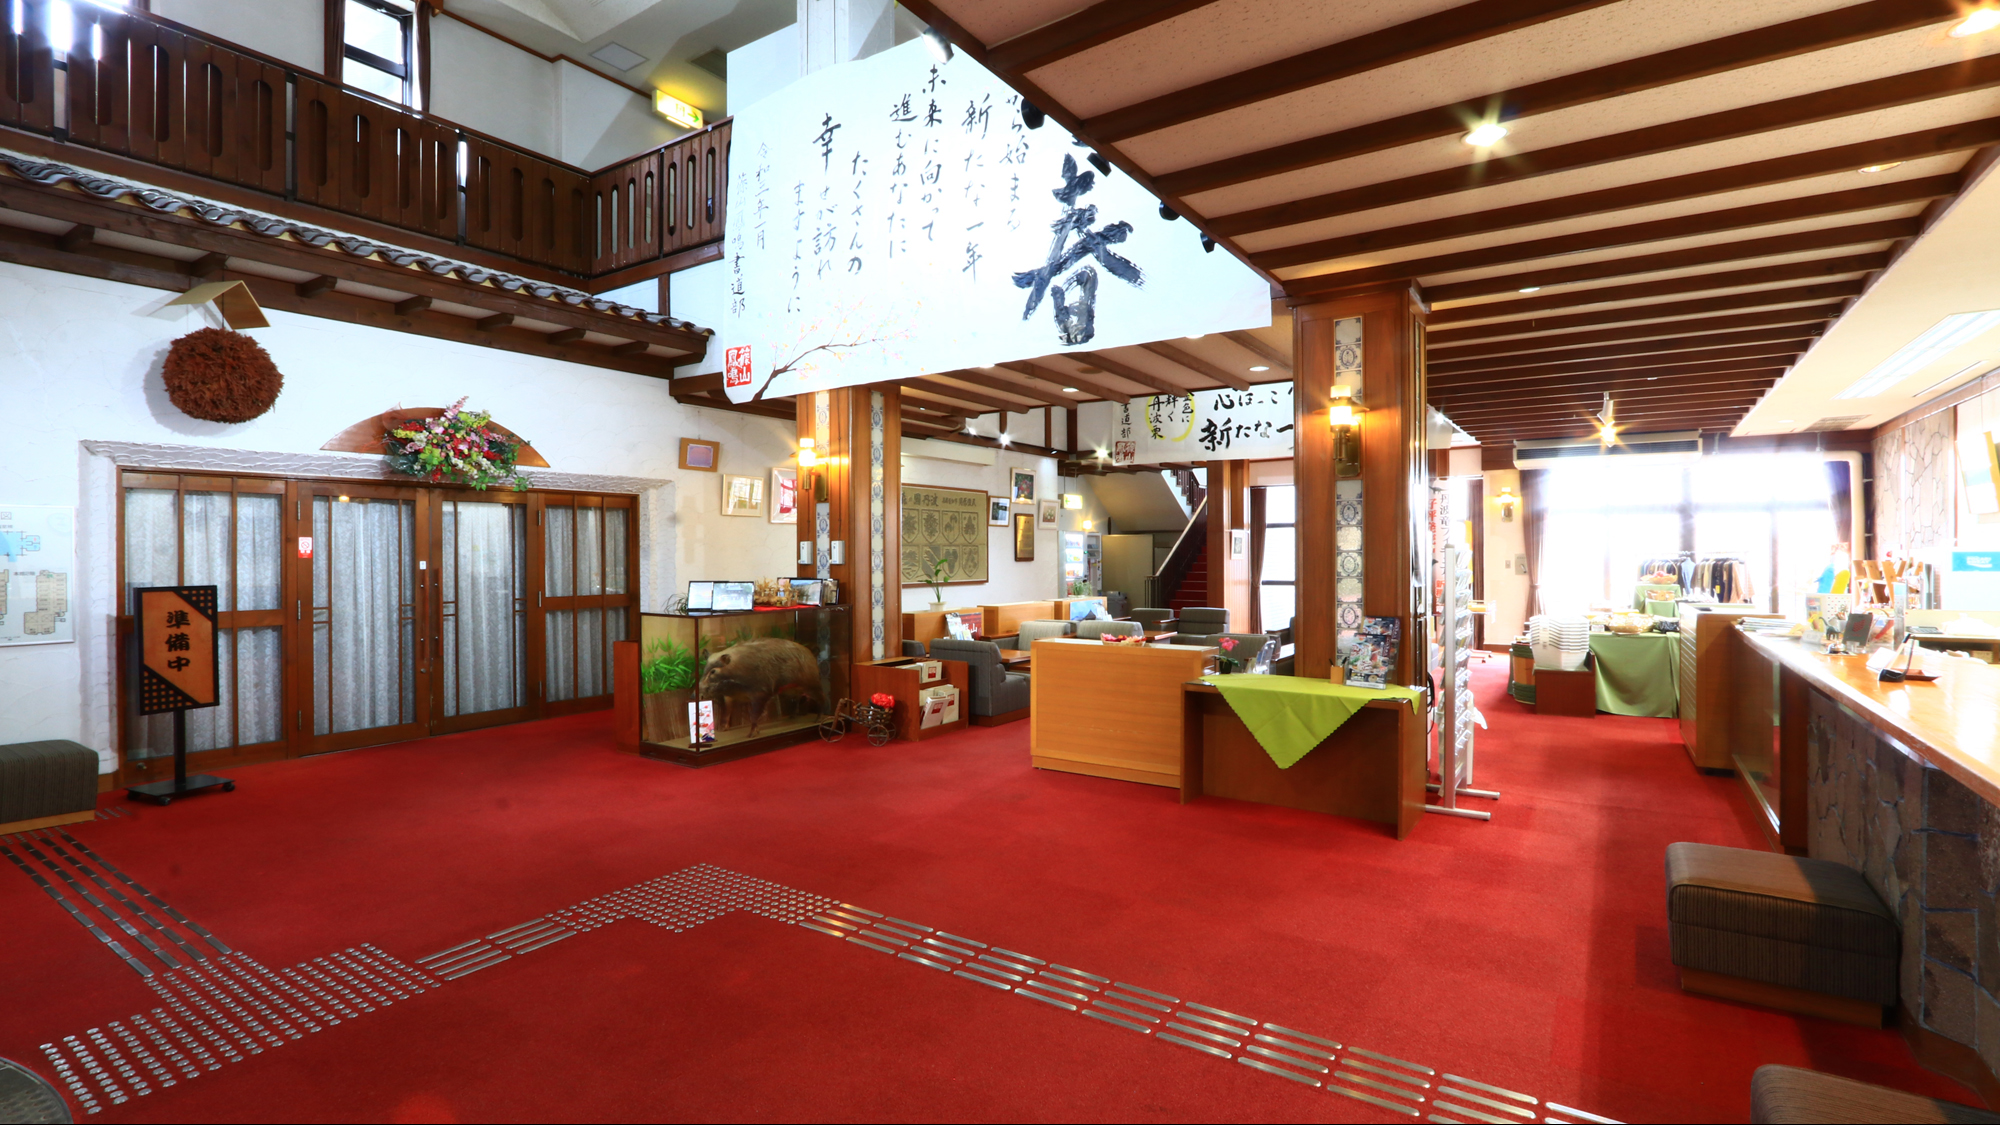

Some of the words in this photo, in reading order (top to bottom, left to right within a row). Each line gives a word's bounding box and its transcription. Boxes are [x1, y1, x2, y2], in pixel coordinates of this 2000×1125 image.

[753, 142, 774, 250] 令和三年一月
[787, 180, 806, 314] ますように
[812, 112, 842, 281] 幸せが訪れ
[847, 150, 869, 276] たくさんの
[887, 93, 919, 259] 進むあなたに
[961, 93, 993, 284] 新たな一年
[1011, 152, 1147, 346] 春
[165, 609, 191, 672] 準備中
